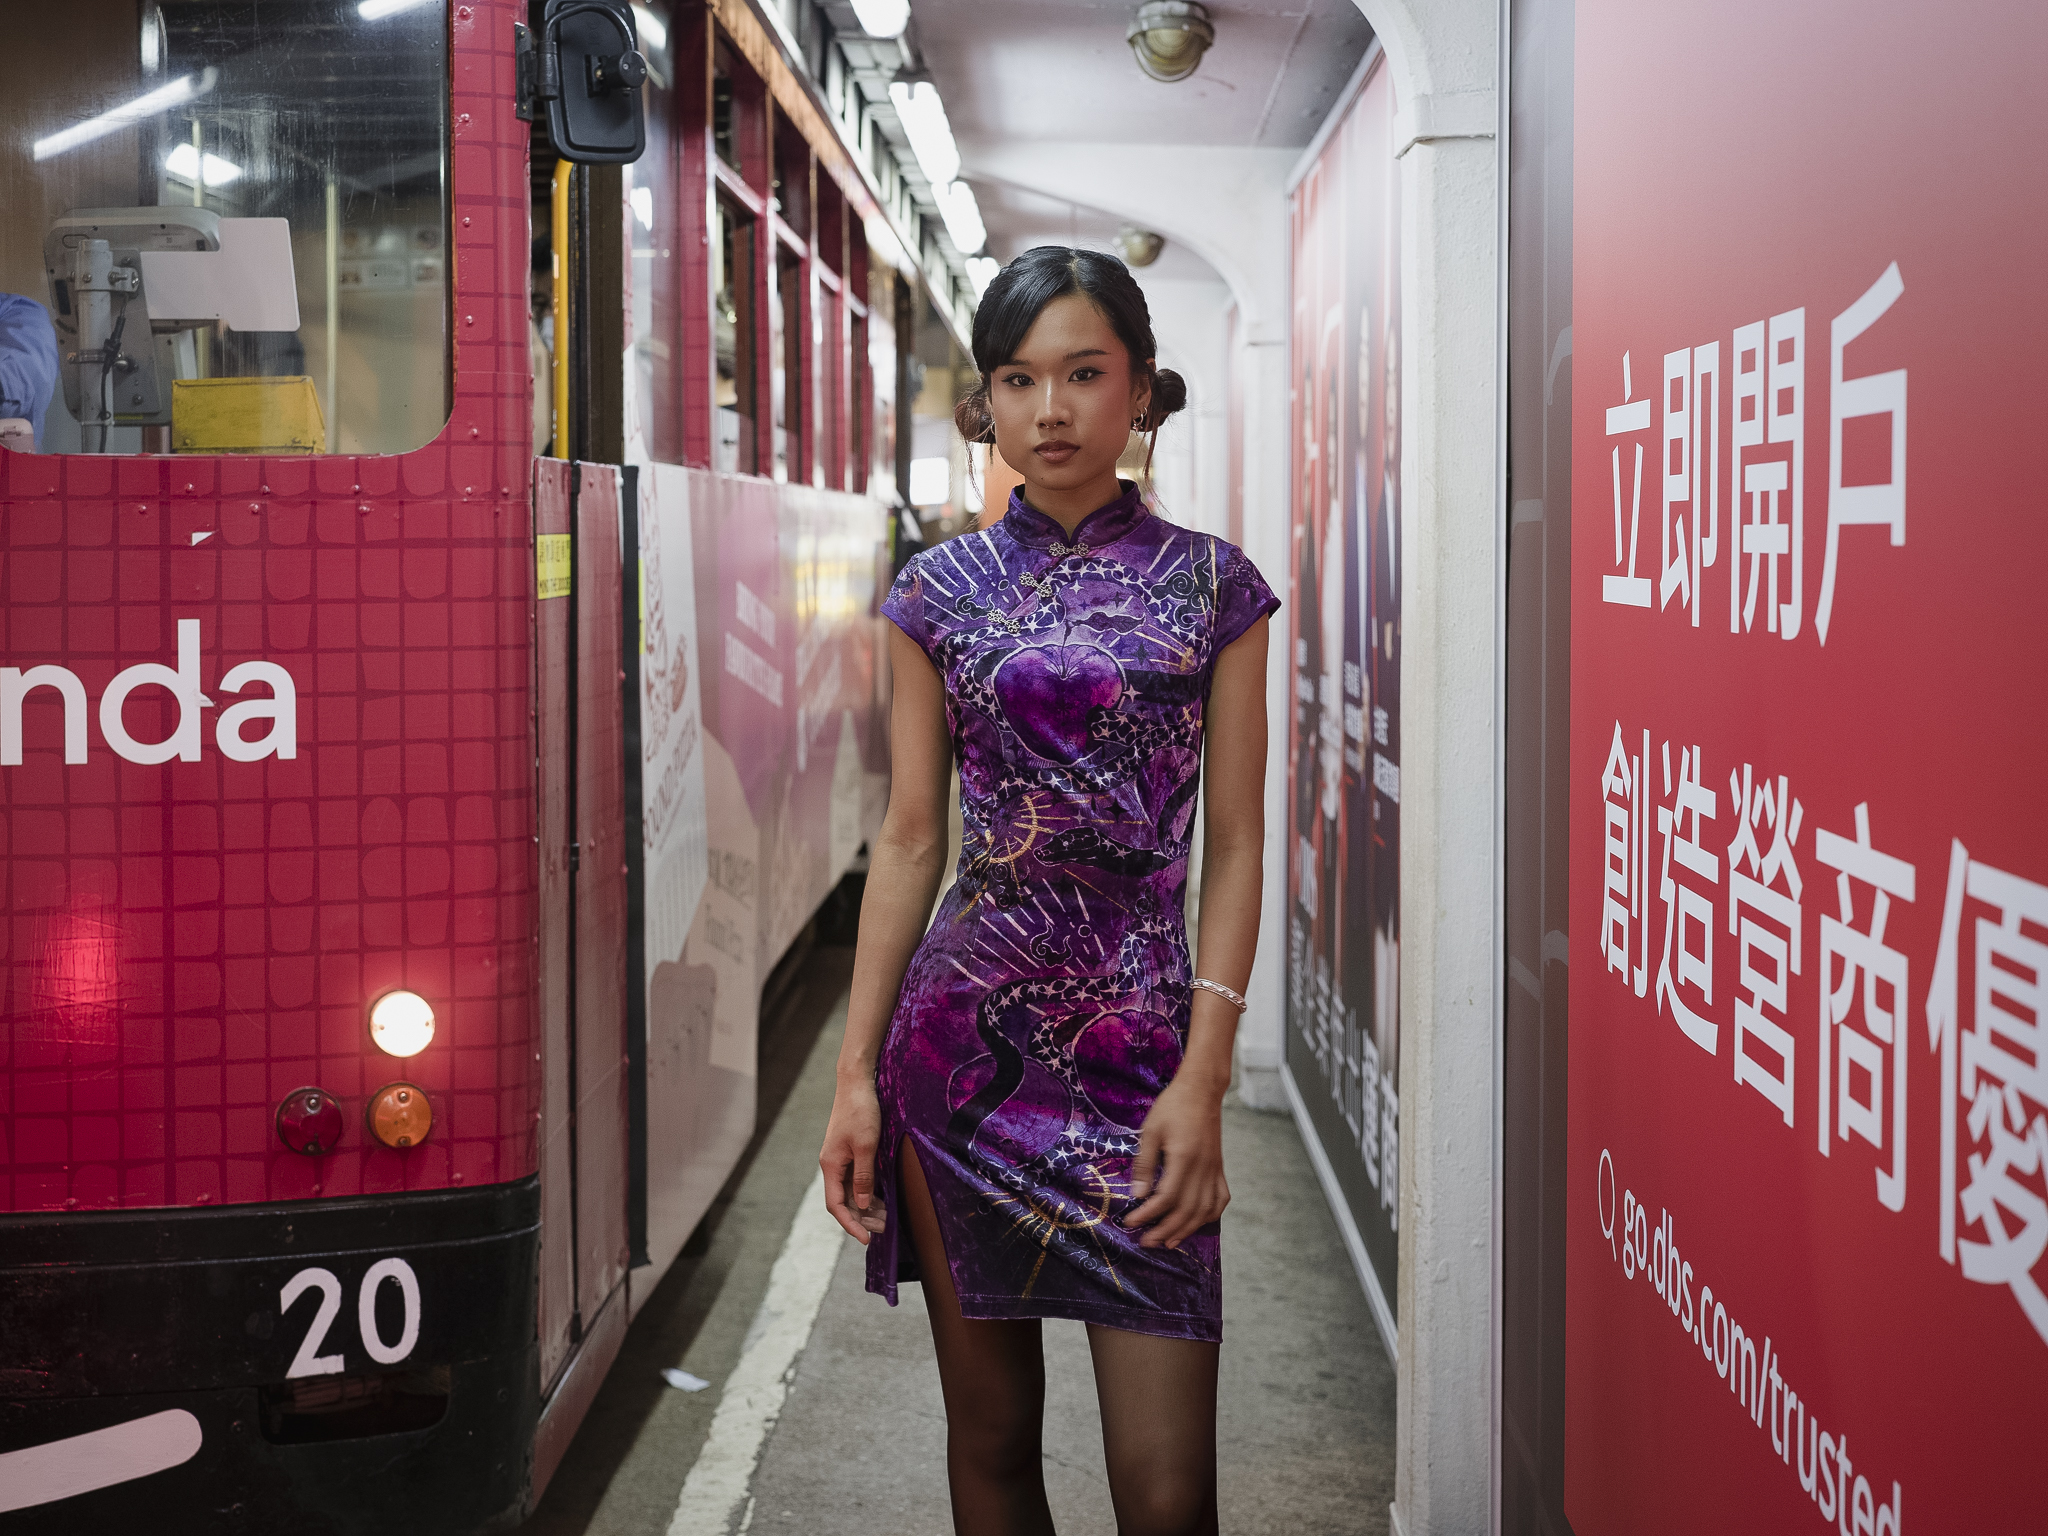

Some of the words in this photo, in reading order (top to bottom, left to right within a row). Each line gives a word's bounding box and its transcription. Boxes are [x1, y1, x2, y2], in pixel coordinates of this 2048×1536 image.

[1602, 260, 1908, 648] 立即開戶
[0, 618, 297, 766] nda
[1600, 719, 2048, 1347] 創造營商優
[280, 1257, 421, 1379] 20
